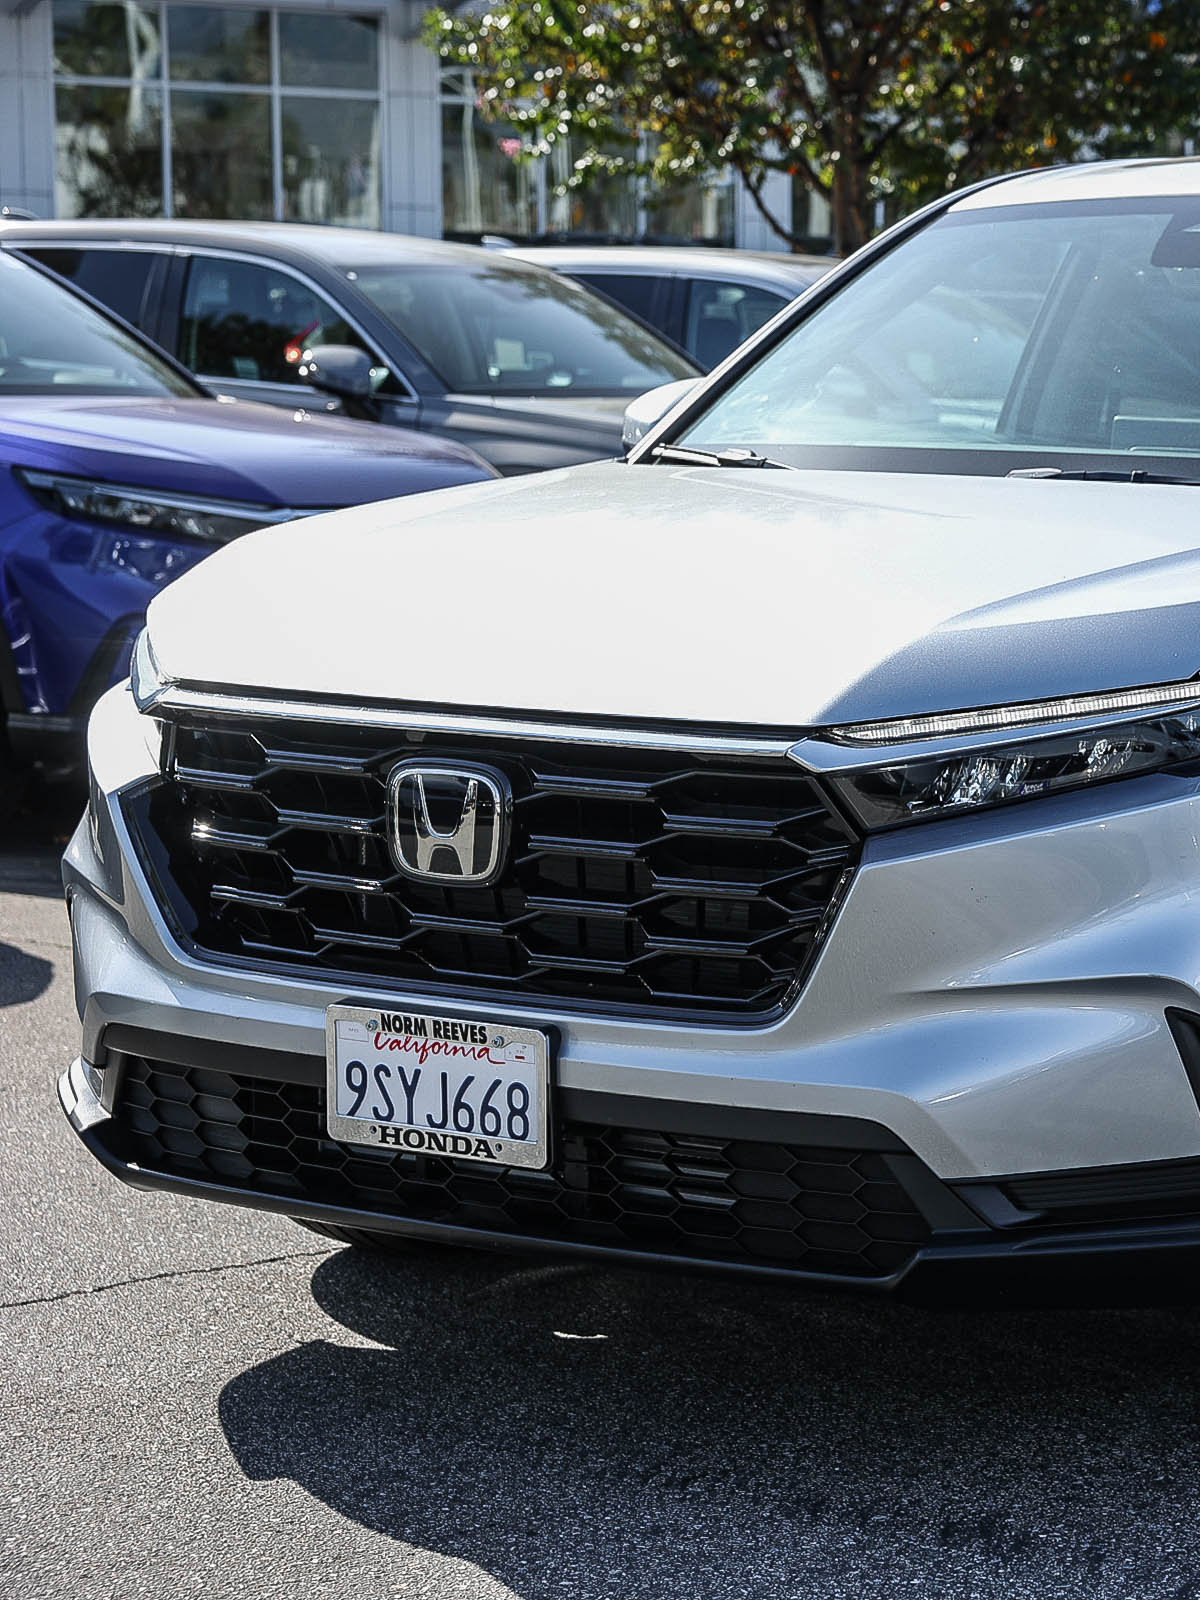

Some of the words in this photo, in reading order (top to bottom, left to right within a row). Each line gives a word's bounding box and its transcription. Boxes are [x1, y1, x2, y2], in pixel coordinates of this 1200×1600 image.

[380, 1013, 427, 1037] NORM
[432, 1020, 488, 1045] REEVES
[373, 1031, 506, 1064] California
[345, 1060, 530, 1141] 9SYJ668
[378, 1125, 497, 1159] HONDA
